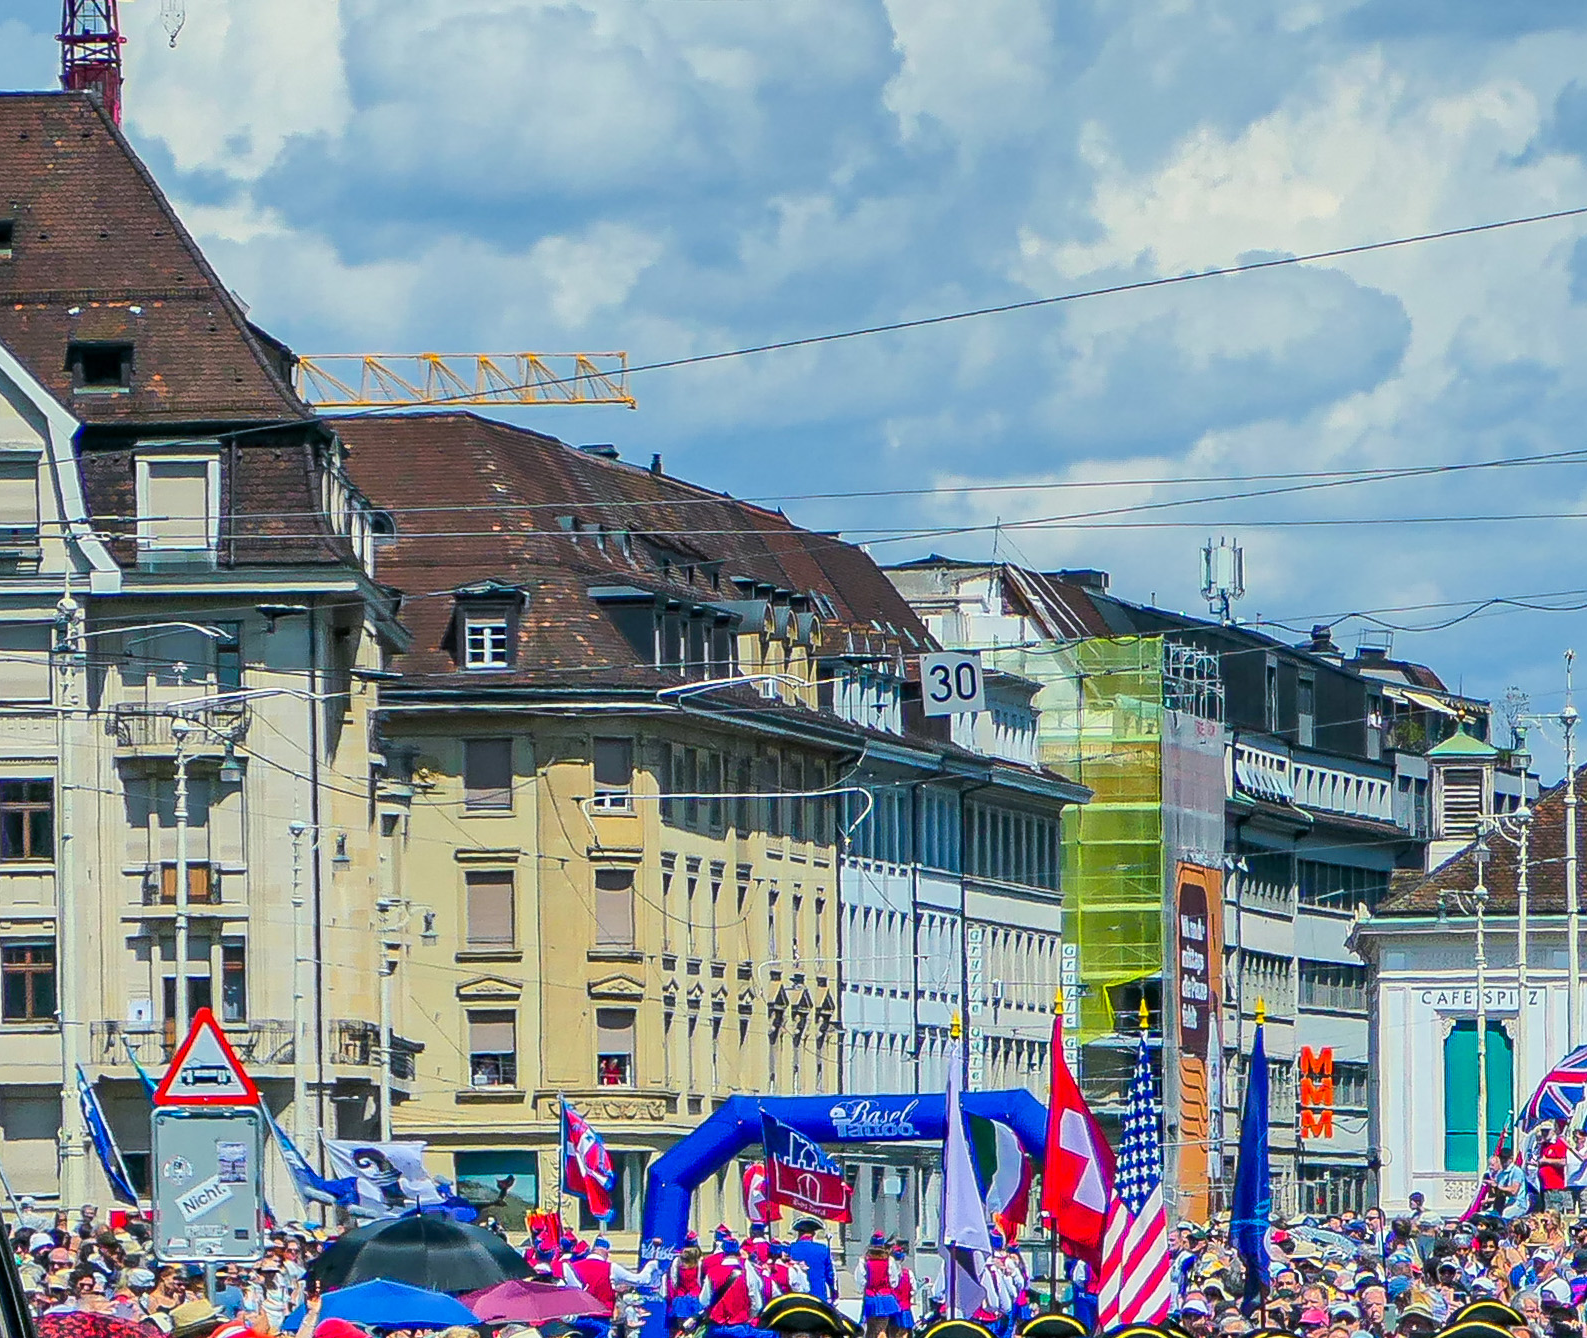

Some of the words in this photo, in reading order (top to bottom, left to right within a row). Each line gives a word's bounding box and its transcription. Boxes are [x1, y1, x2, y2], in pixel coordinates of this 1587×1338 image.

[929, 662, 977, 703] 30
[1483, 990, 1538, 1005] SPIZ
[848, 1099, 920, 1125] Basel
